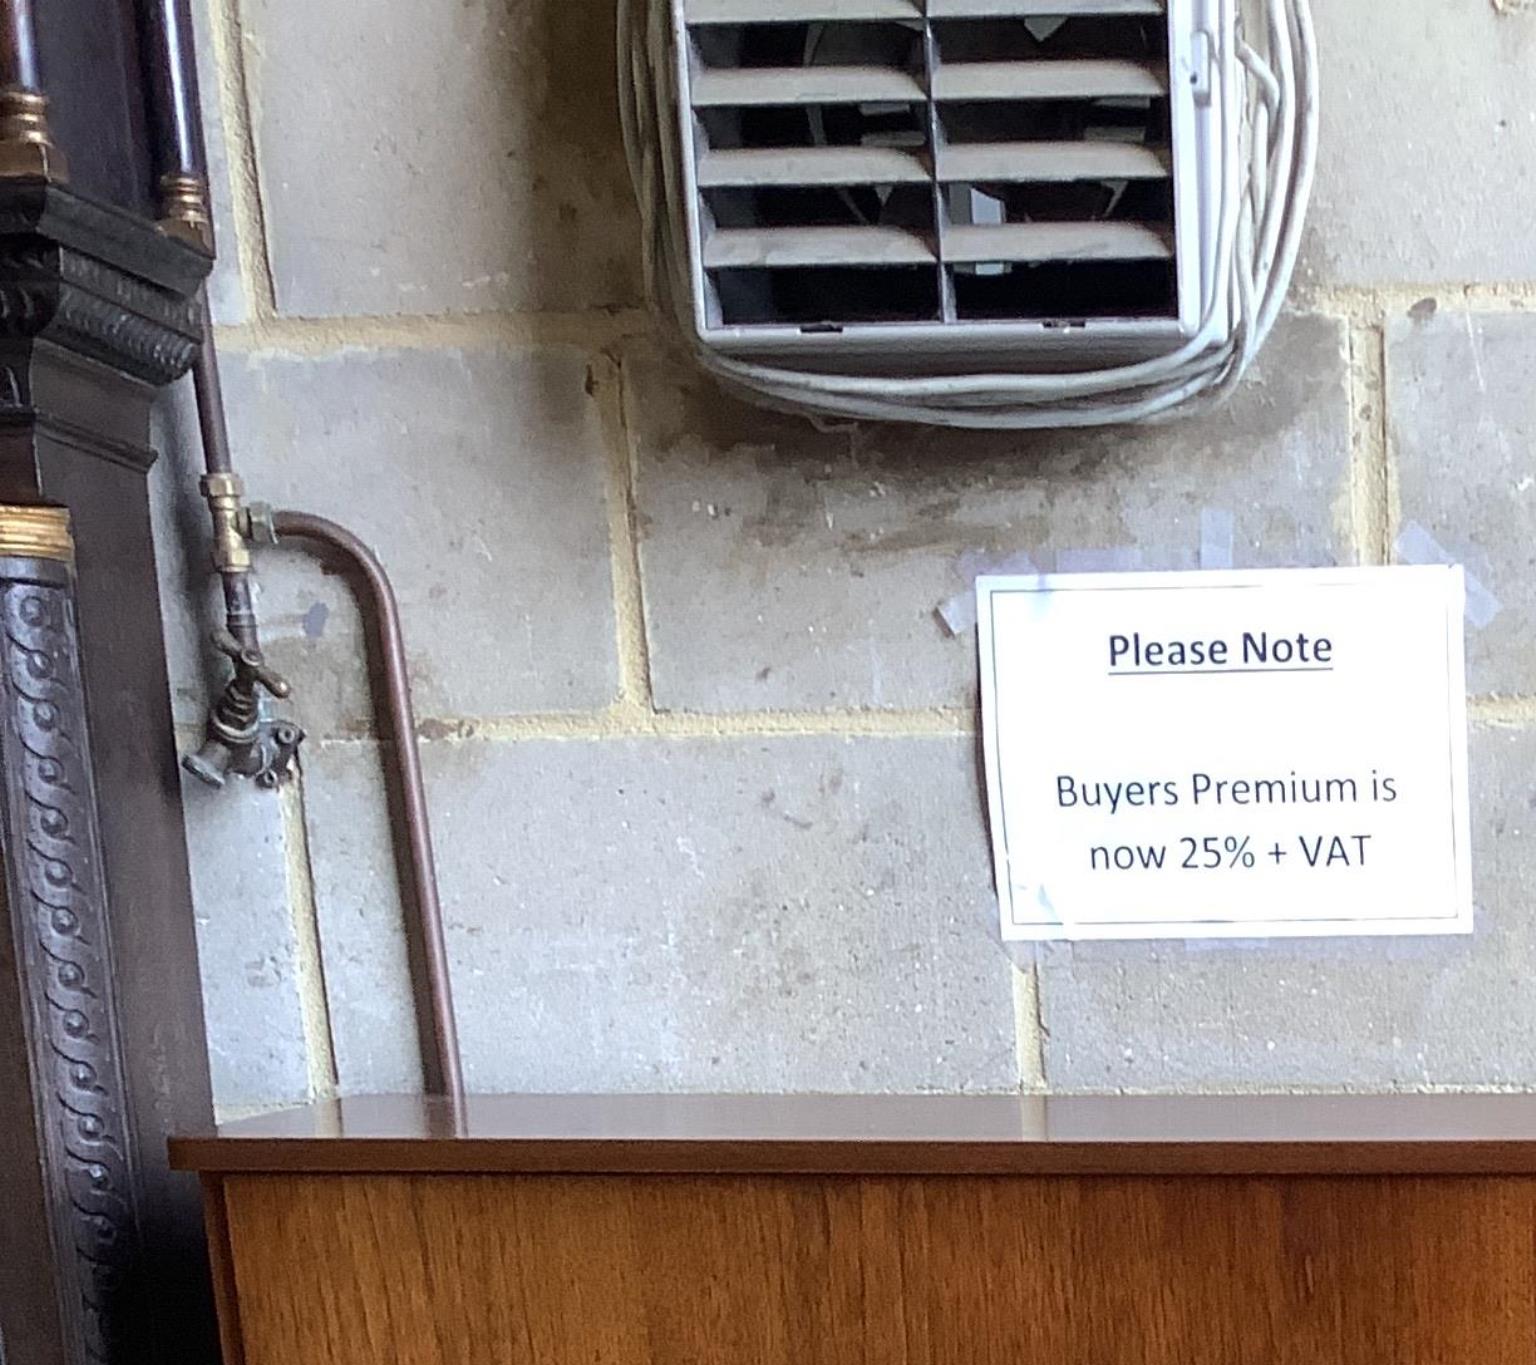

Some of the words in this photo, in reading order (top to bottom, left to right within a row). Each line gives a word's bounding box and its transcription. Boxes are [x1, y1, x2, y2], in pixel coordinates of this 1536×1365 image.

[1110, 633, 1227, 666] Please
[1243, 632, 1331, 663] Note
[1058, 776, 1178, 814] Buyers
[1193, 772, 1356, 804] Premium
[1373, 770, 1396, 801] is
[1091, 846, 1166, 869] now
[1181, 836, 1254, 868] 25%
[1269, 843, 1286, 863] +
[1299, 836, 1371, 866] VAT
